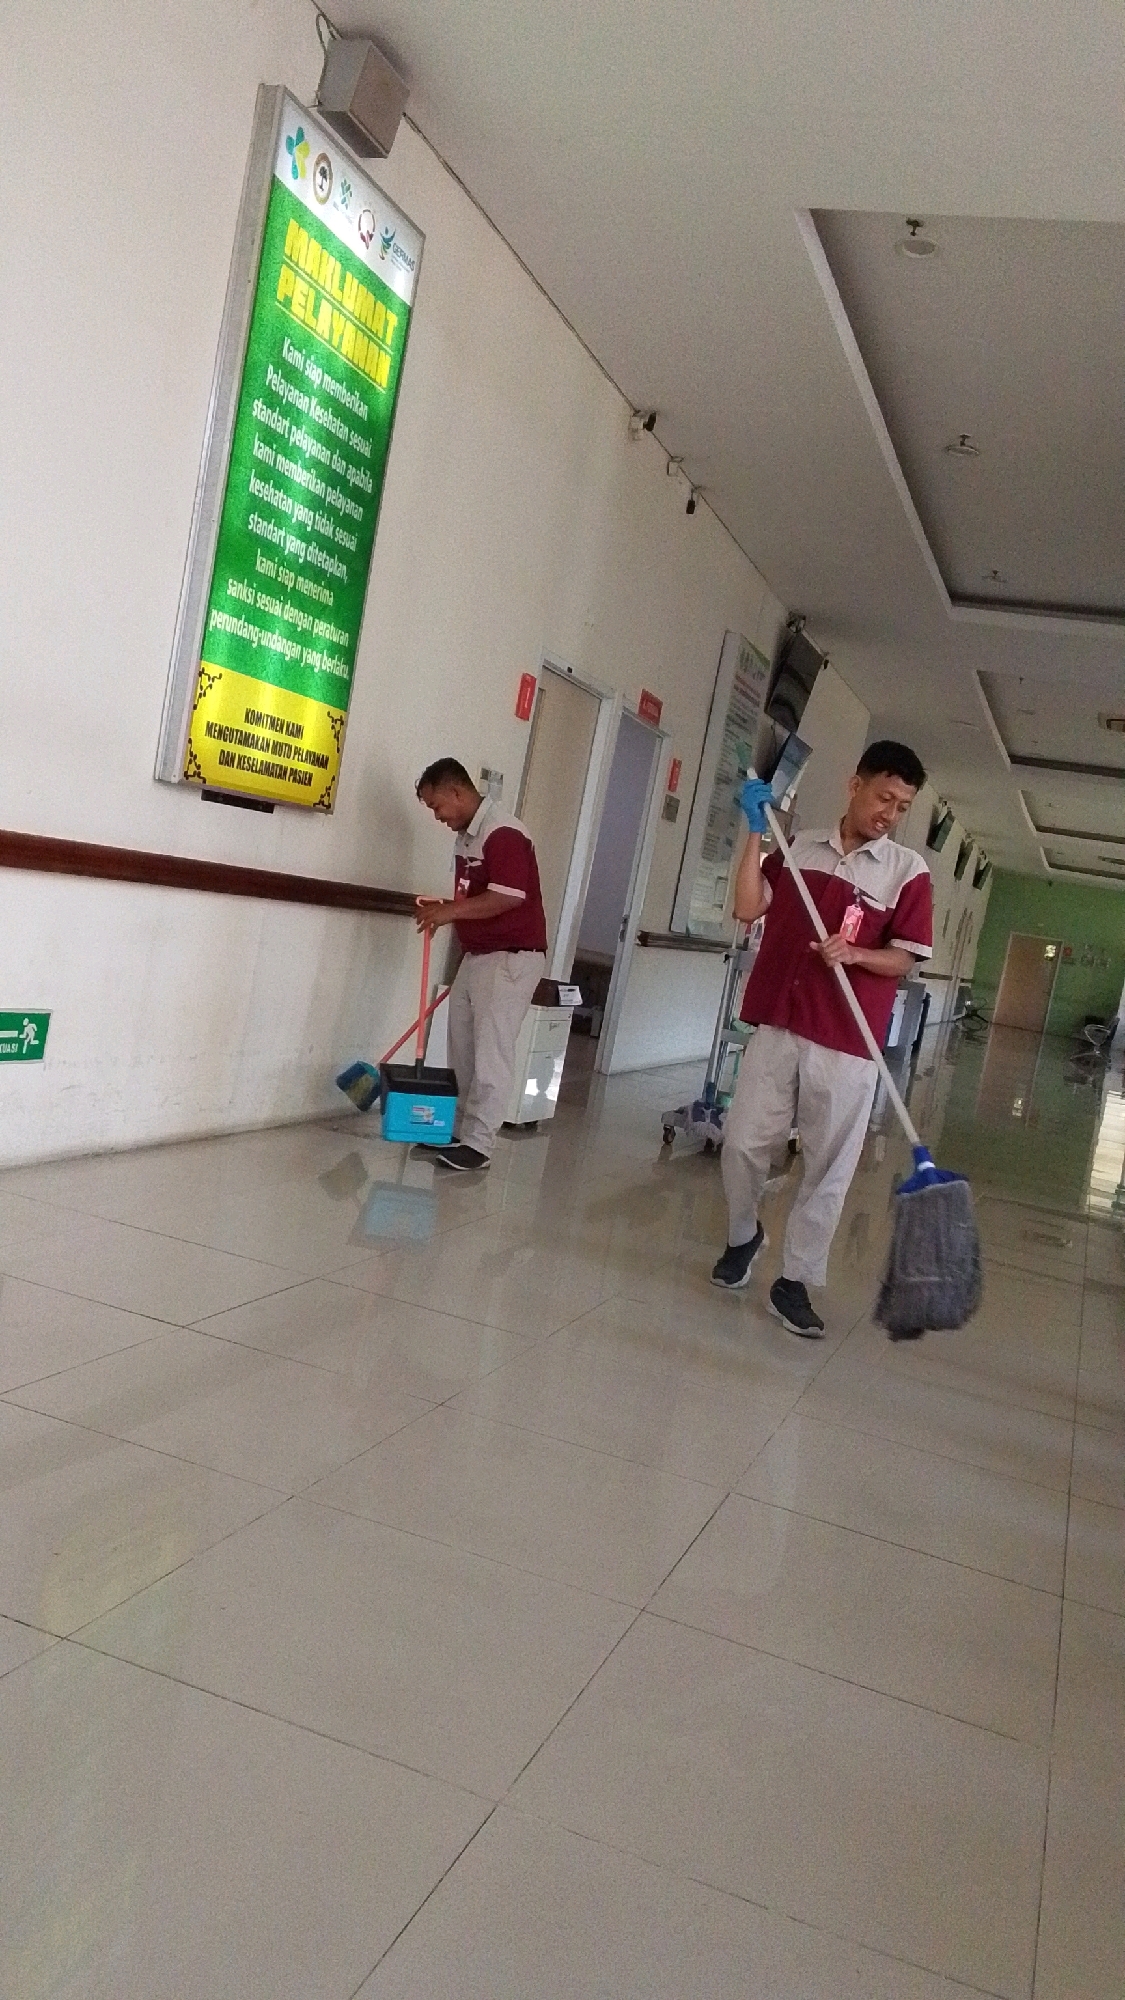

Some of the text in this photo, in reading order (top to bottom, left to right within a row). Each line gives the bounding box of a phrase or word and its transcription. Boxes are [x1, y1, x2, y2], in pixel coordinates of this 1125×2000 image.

[284, 218, 398, 346] MAKLUMAT
[392, 243, 415, 271] GERMAS
[276, 264, 391, 388] PELAYANAN
[266, 363, 373, 459] Pelayanan Kesehatan sesuai
[282, 336, 368, 421] Kami siap memberikan
[252, 398, 373, 494] standart pelayanan dan apabila
[253, 432, 363, 522] kami memberikan pelayanan
[249, 469, 358, 553] kesehatan yang tidak sesuai
[248, 512, 348, 584] standart yang ditetapkan,
[255, 548, 334, 606] kami siap menerima
[209, 608, 349, 680] perundang-undangan yang berlaku.
[227, 578, 349, 647] sanksi sesuai dengan peraturan
[204, 720, 330, 770] MENGUTAMAKAN MUTU PELAYANAN
[244, 707, 305, 740] KOMITMEN KAMI
[218, 749, 314, 787] DAN KESELAMATAN PASIEN
